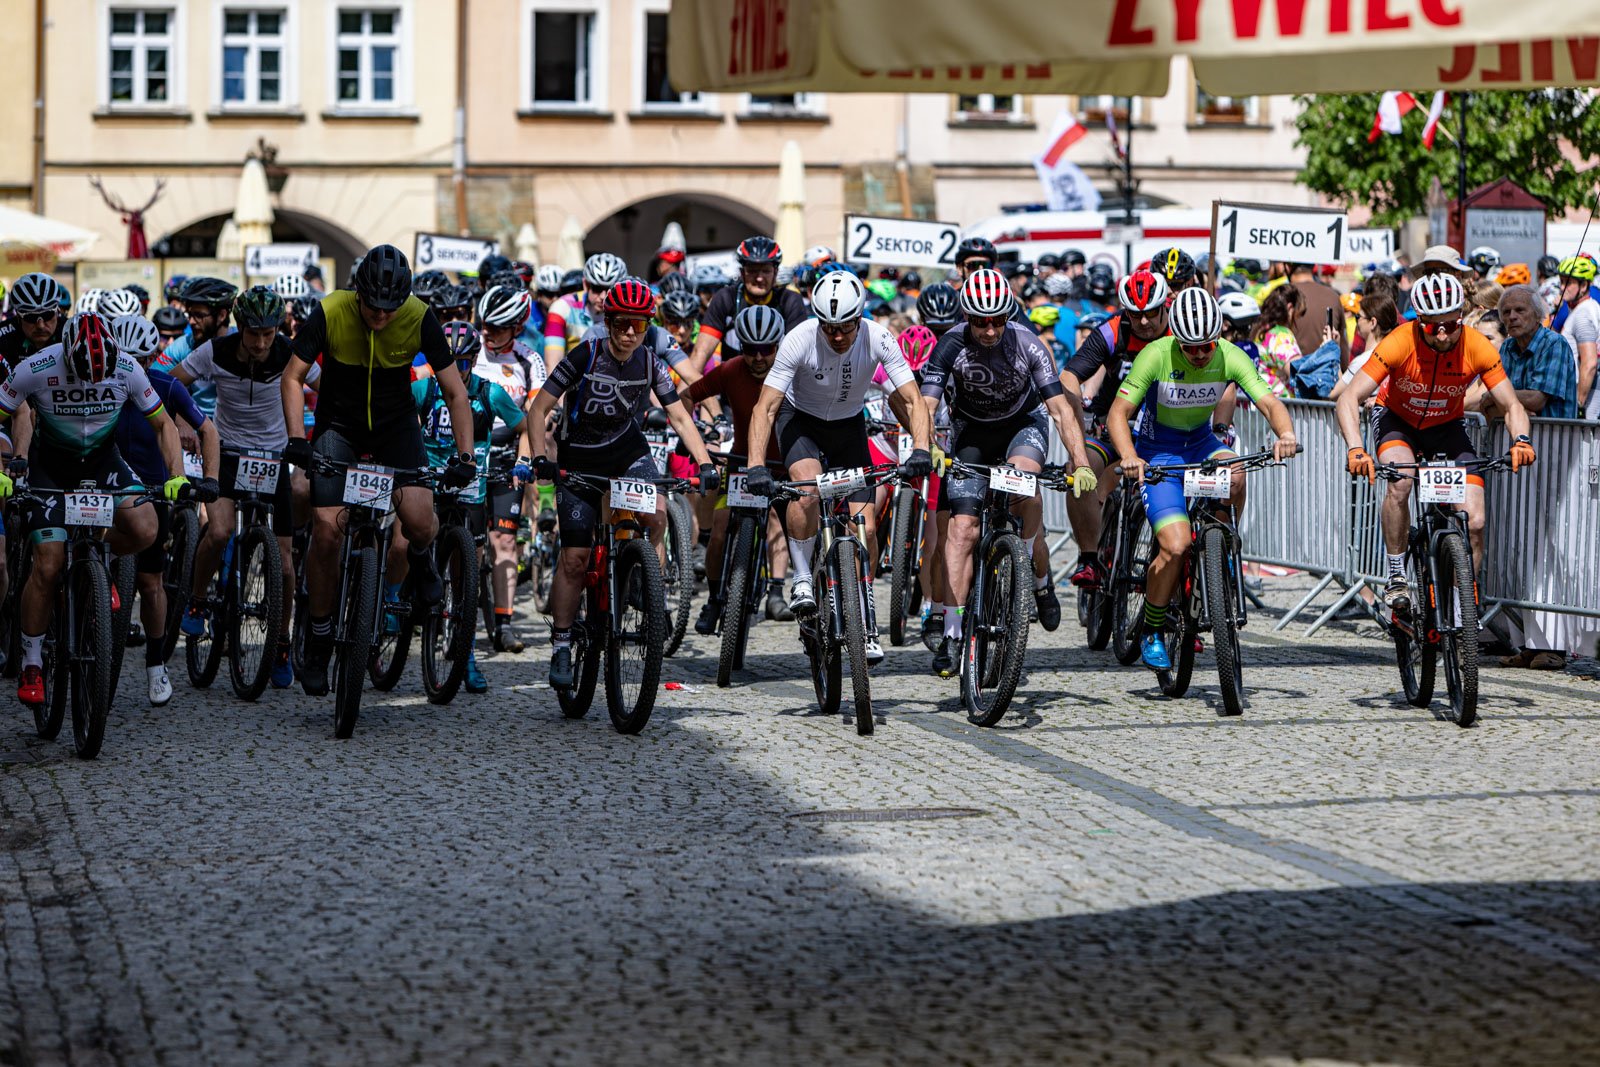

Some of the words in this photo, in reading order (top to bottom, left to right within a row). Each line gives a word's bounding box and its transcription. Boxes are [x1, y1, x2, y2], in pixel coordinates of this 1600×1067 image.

[853, 222, 872, 258] 2
[876, 237, 933, 254] SEKTOR
[937, 229, 957, 264] 2
[1222, 210, 1238, 253] 1
[1249, 228, 1316, 248] SEKTOR
[1327, 217, 1343, 260] 1
[1349, 237, 1372, 252] UN
[1381, 231, 1389, 256] 1
[251, 248, 261, 269] 4
[420, 236, 433, 264] 3
[30, 355, 55, 368] BORA
[119, 356, 134, 367] ORA
[1028, 343, 1053, 381] RADEK
[653, 360, 674, 389] YLWIA
[842, 361, 852, 390] RYSEL
[52, 388, 116, 403] BORA
[1169, 387, 1217, 399] TRASA
[55, 403, 114, 416] hansgrohe
[651, 446, 666, 458] 74
[242, 460, 277, 477] 1538
[350, 472, 390, 492] 1848
[1423, 470, 1463, 485] 1882
[614, 481, 654, 495] 1706
[69, 495, 110, 508] 1437
